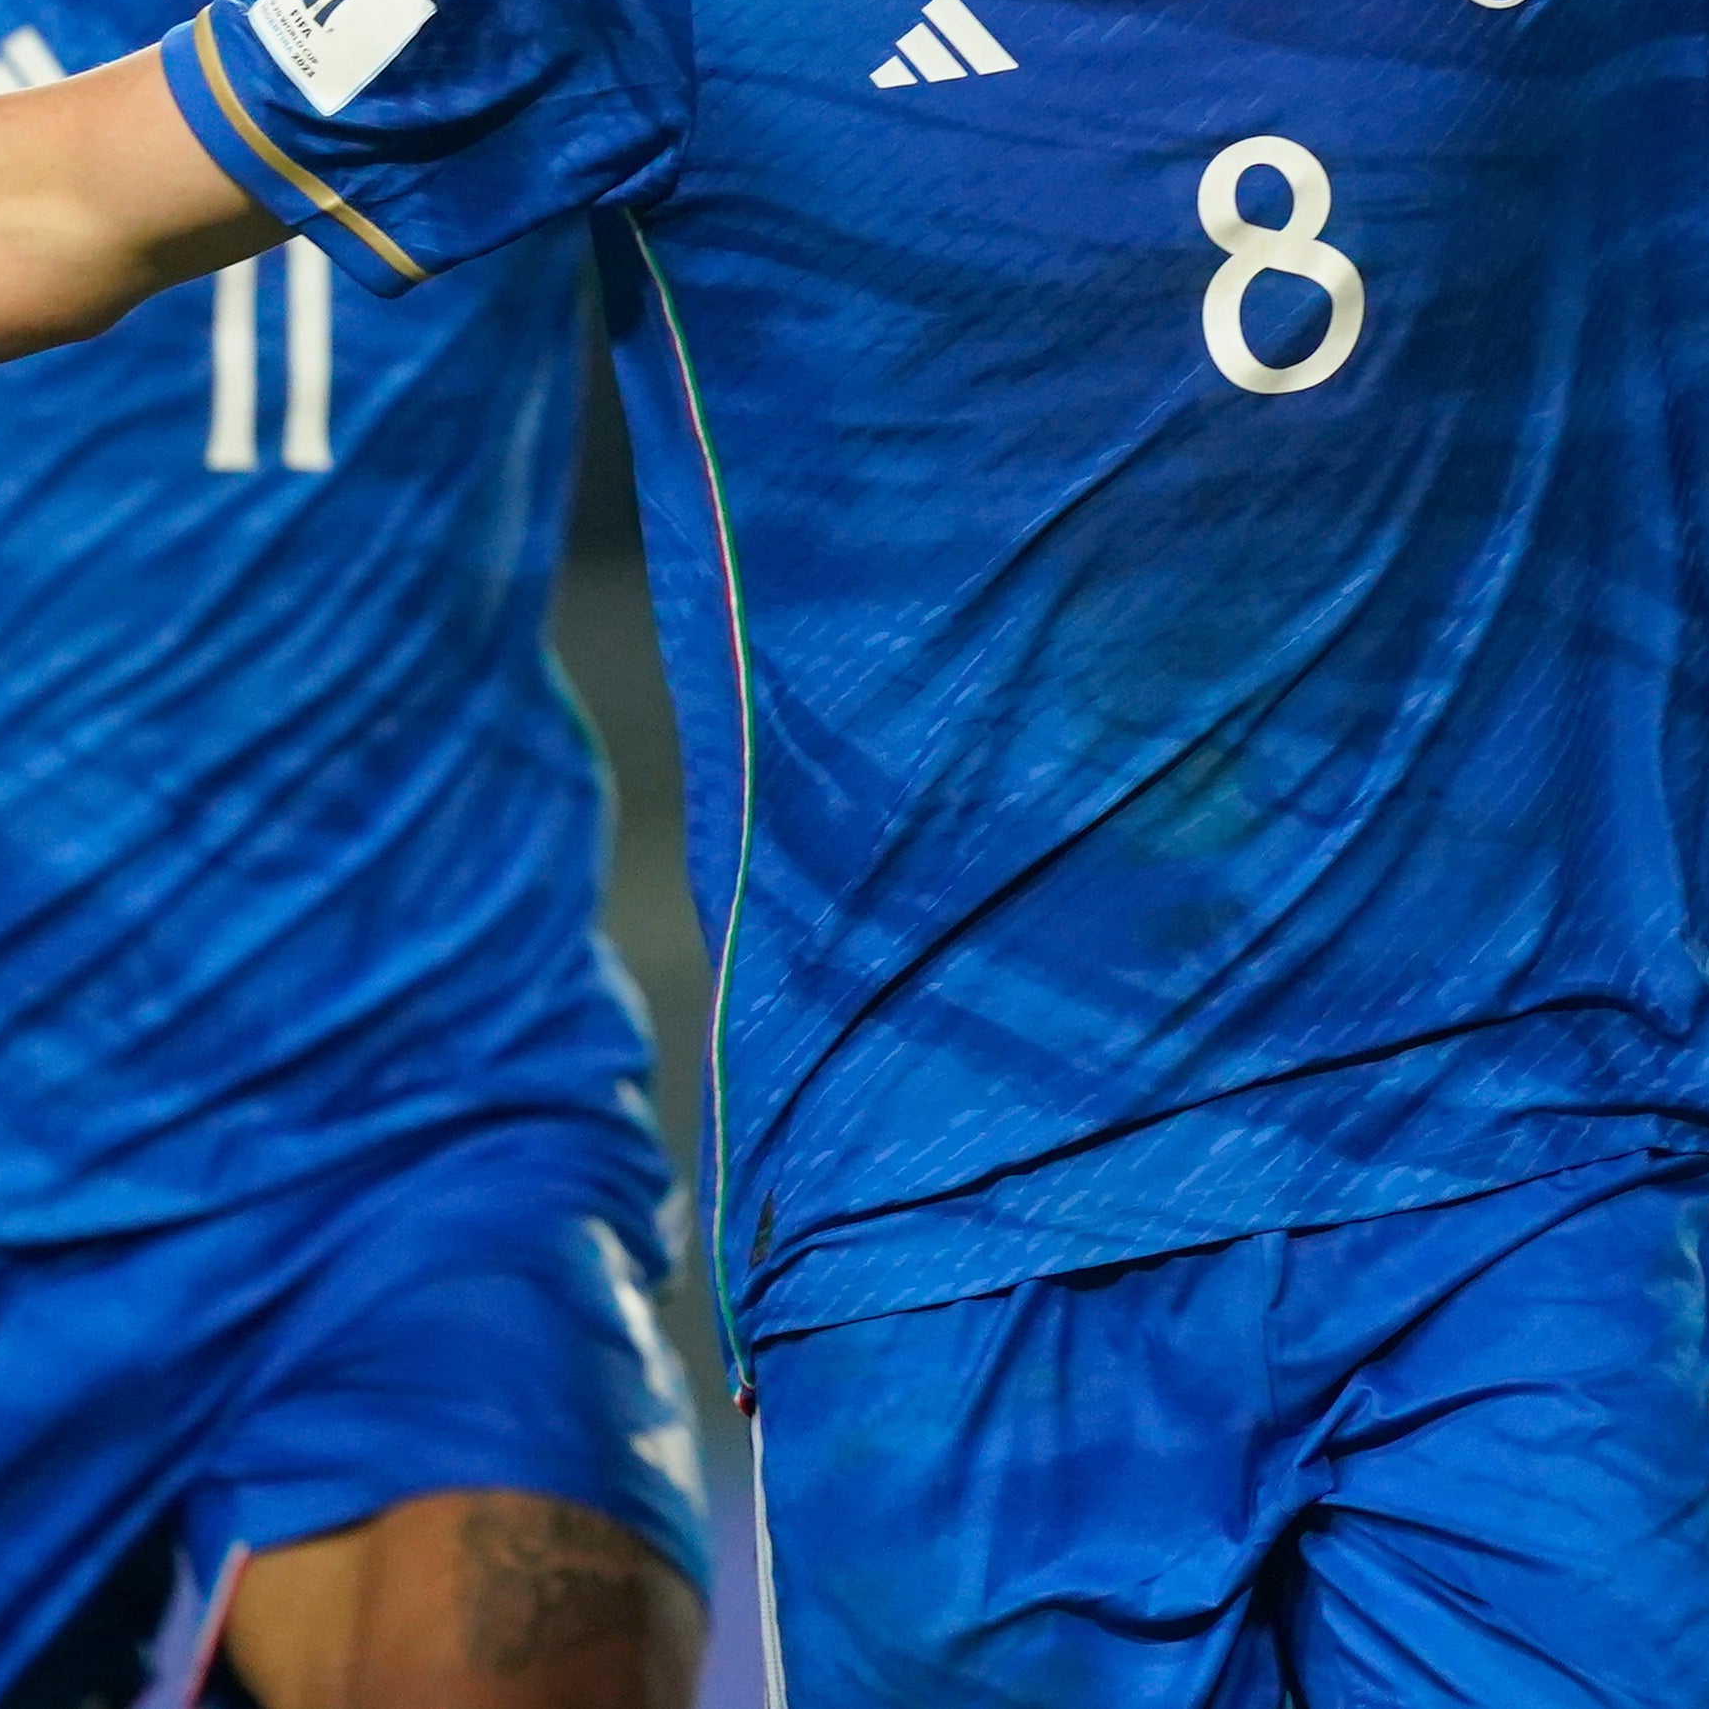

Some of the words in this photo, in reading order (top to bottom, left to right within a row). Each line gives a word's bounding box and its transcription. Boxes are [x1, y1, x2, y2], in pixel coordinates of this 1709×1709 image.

[290, 9, 312, 39] FIFA
[205, 234, 334, 472] 11
[1197, 135, 1365, 394] 8
